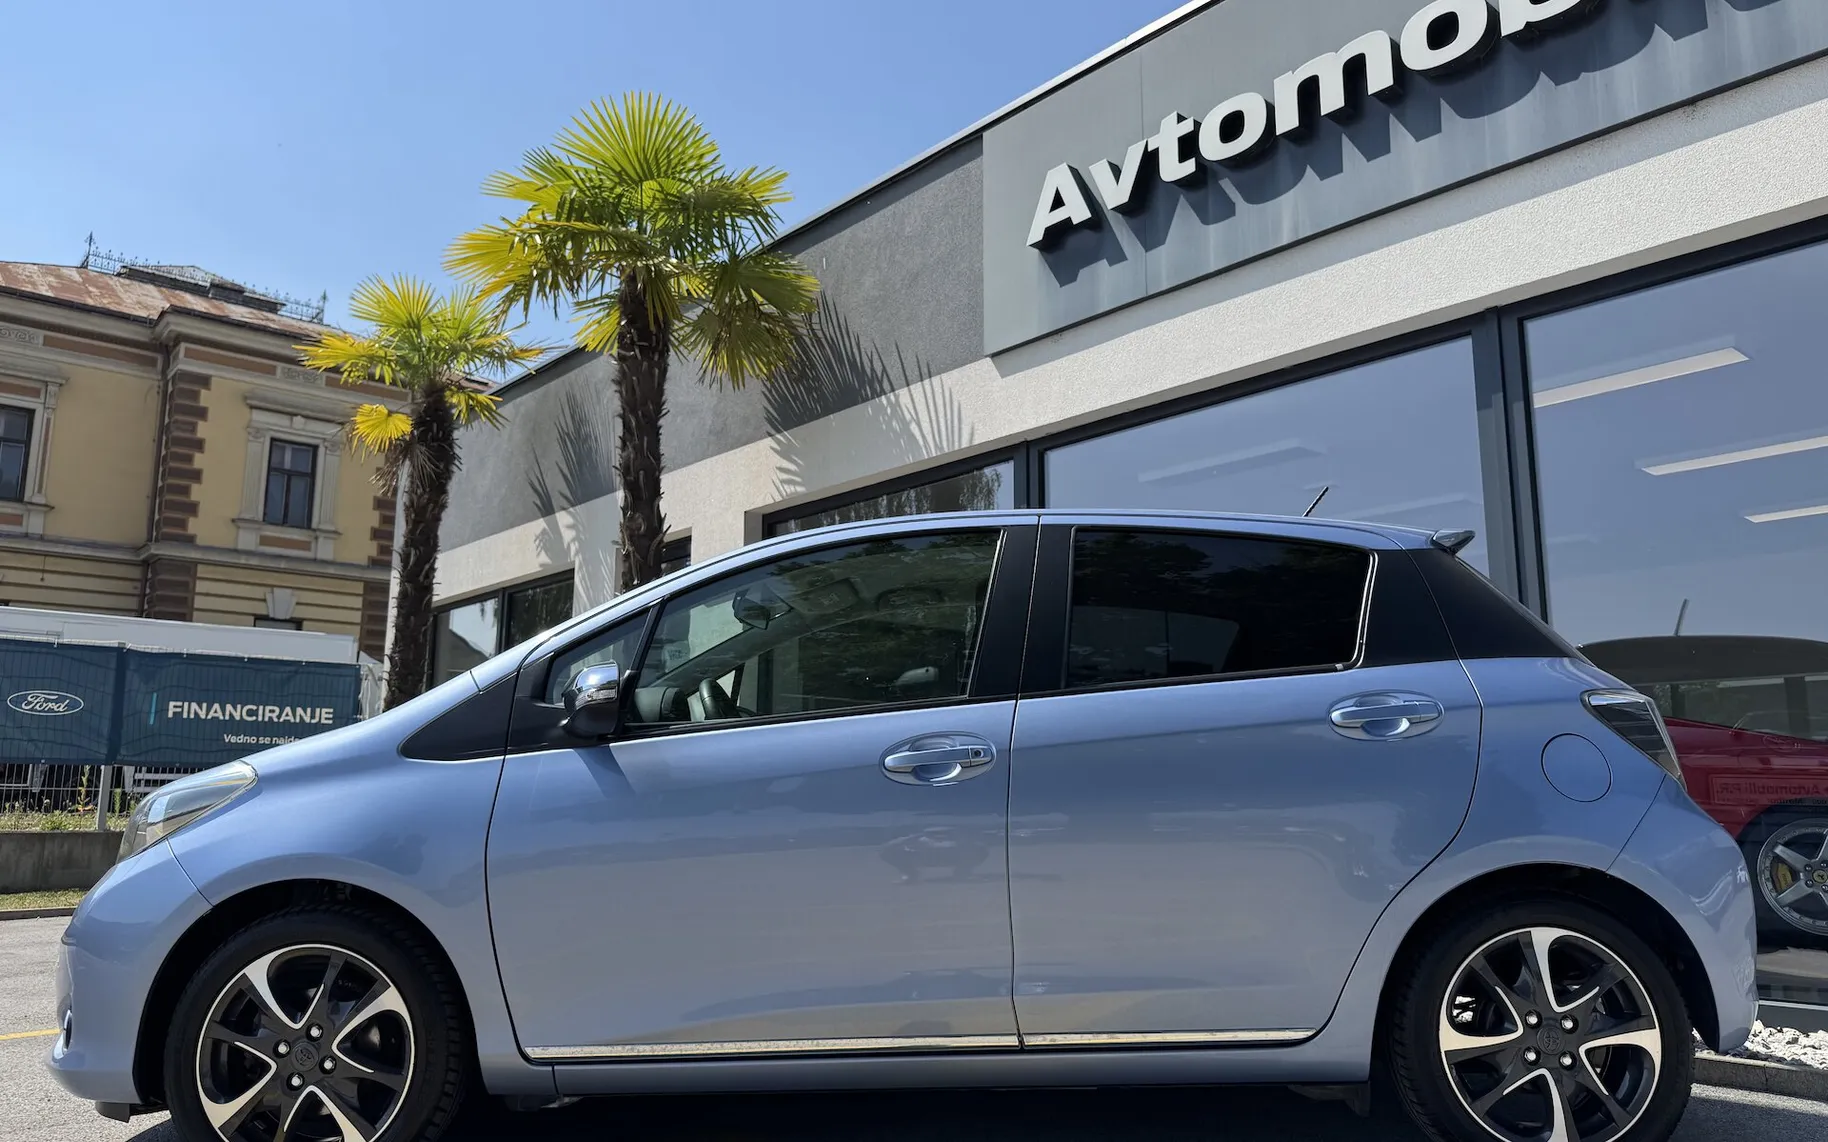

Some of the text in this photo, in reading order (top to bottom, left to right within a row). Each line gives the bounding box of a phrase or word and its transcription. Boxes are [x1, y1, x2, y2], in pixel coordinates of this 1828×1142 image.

[22, 693, 70, 711] Ford
[167, 701, 334, 724] FINANCIRANJE
[223, 733, 257, 744] Vedno
[258, 736, 271, 744] se
